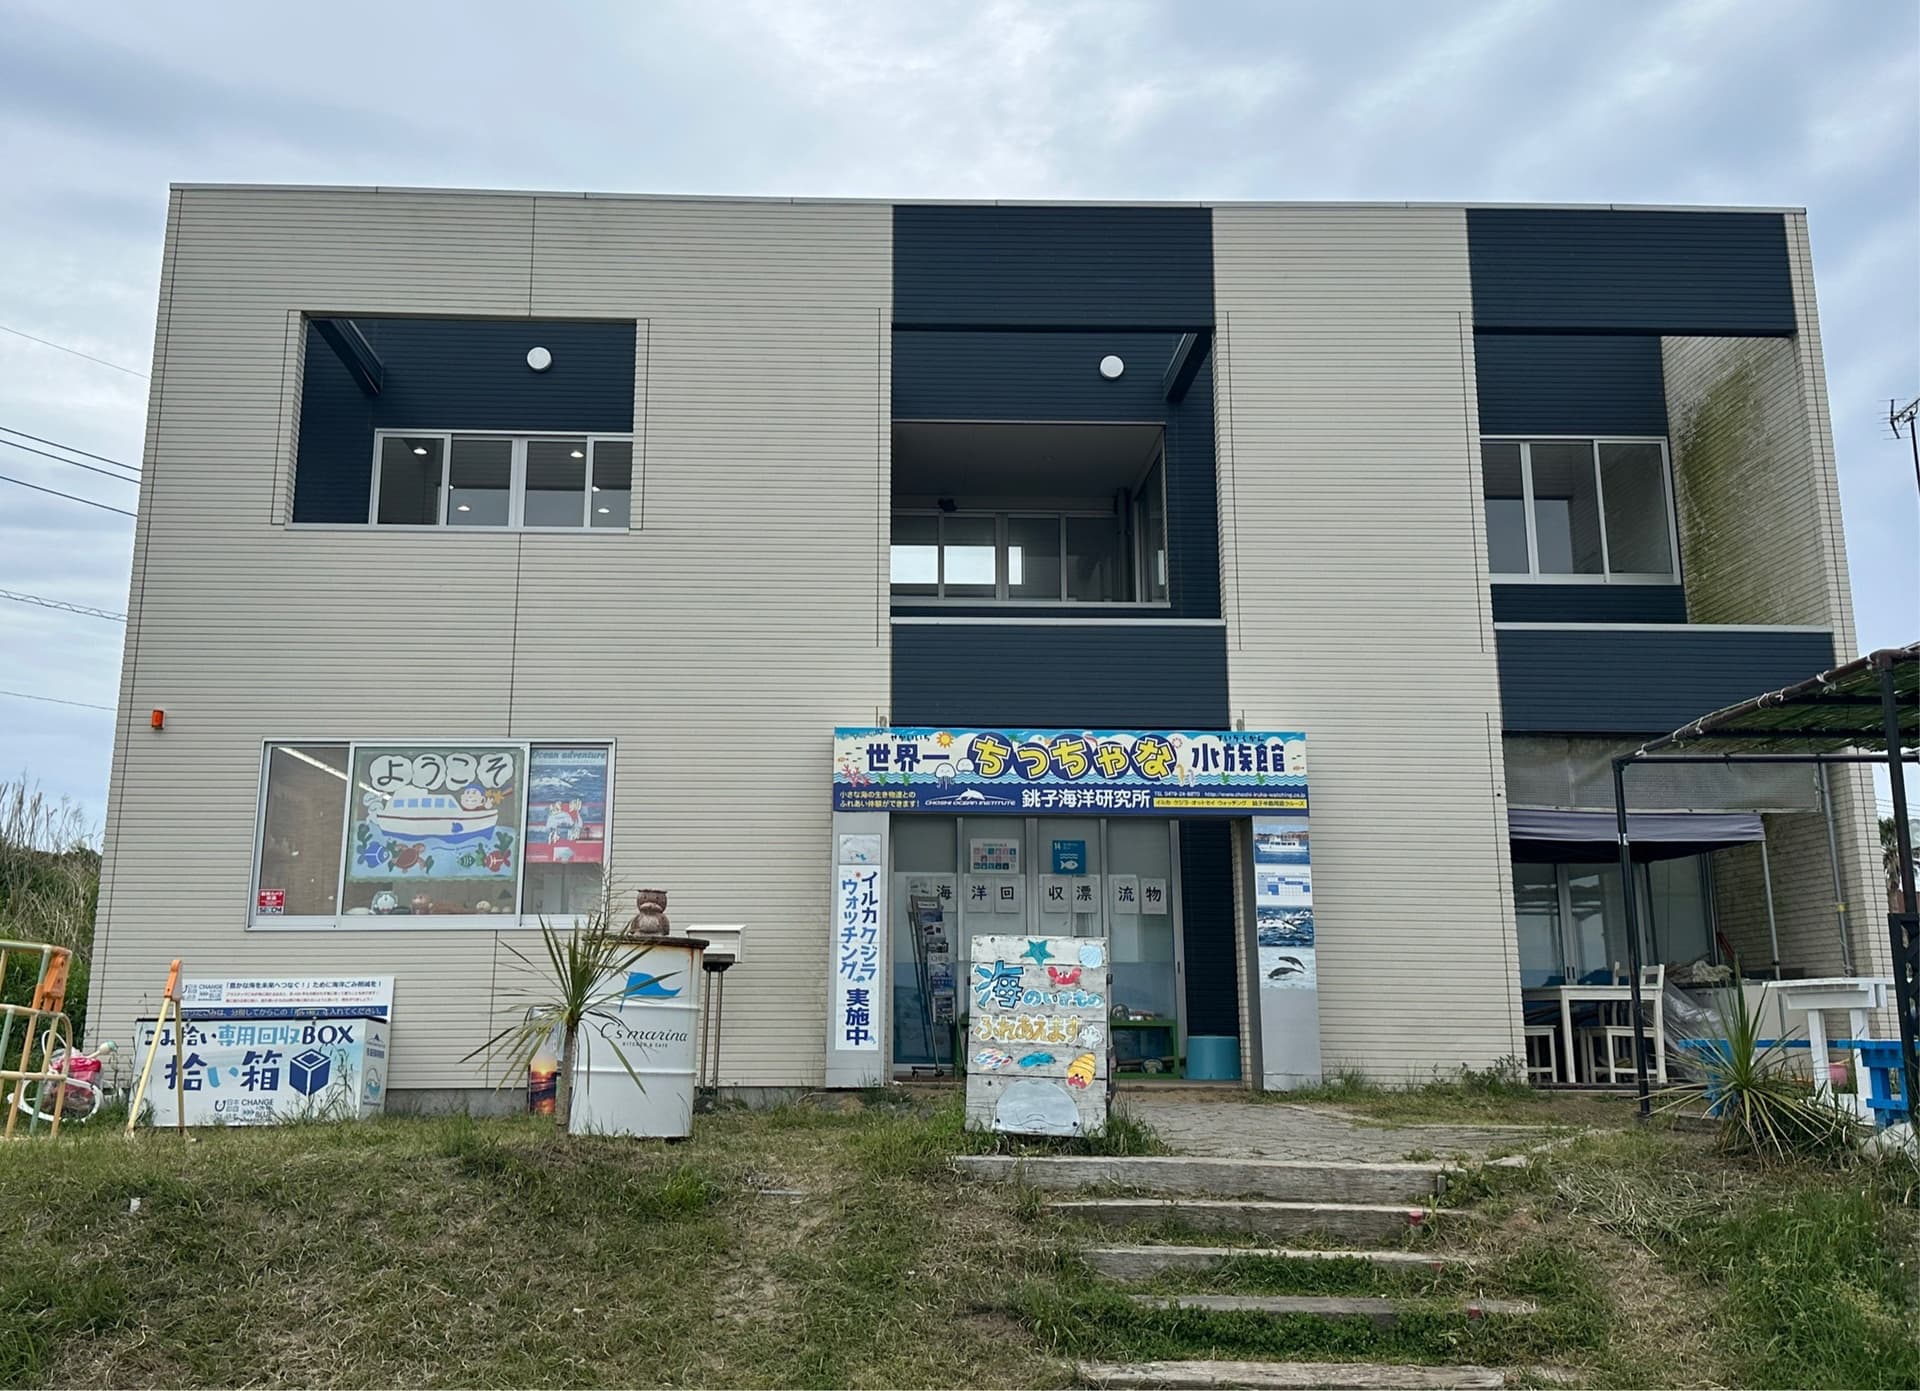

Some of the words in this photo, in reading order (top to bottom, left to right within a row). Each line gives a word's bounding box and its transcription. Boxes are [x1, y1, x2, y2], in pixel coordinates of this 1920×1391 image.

[376, 755, 508, 787] ようこそ
[866, 743, 950, 772] 世界一
[974, 736, 1176, 780] ちっちゃな
[1192, 743, 1285, 773] 水族館
[1021, 788, 1151, 809] 銚子海洋研究所
[973, 959, 1104, 1010] 海のいきもの
[845, 988, 870, 1046] 実施中
[974, 1015, 1082, 1043] ふれあえます
[164, 1050, 283, 1092] 拾い箱
